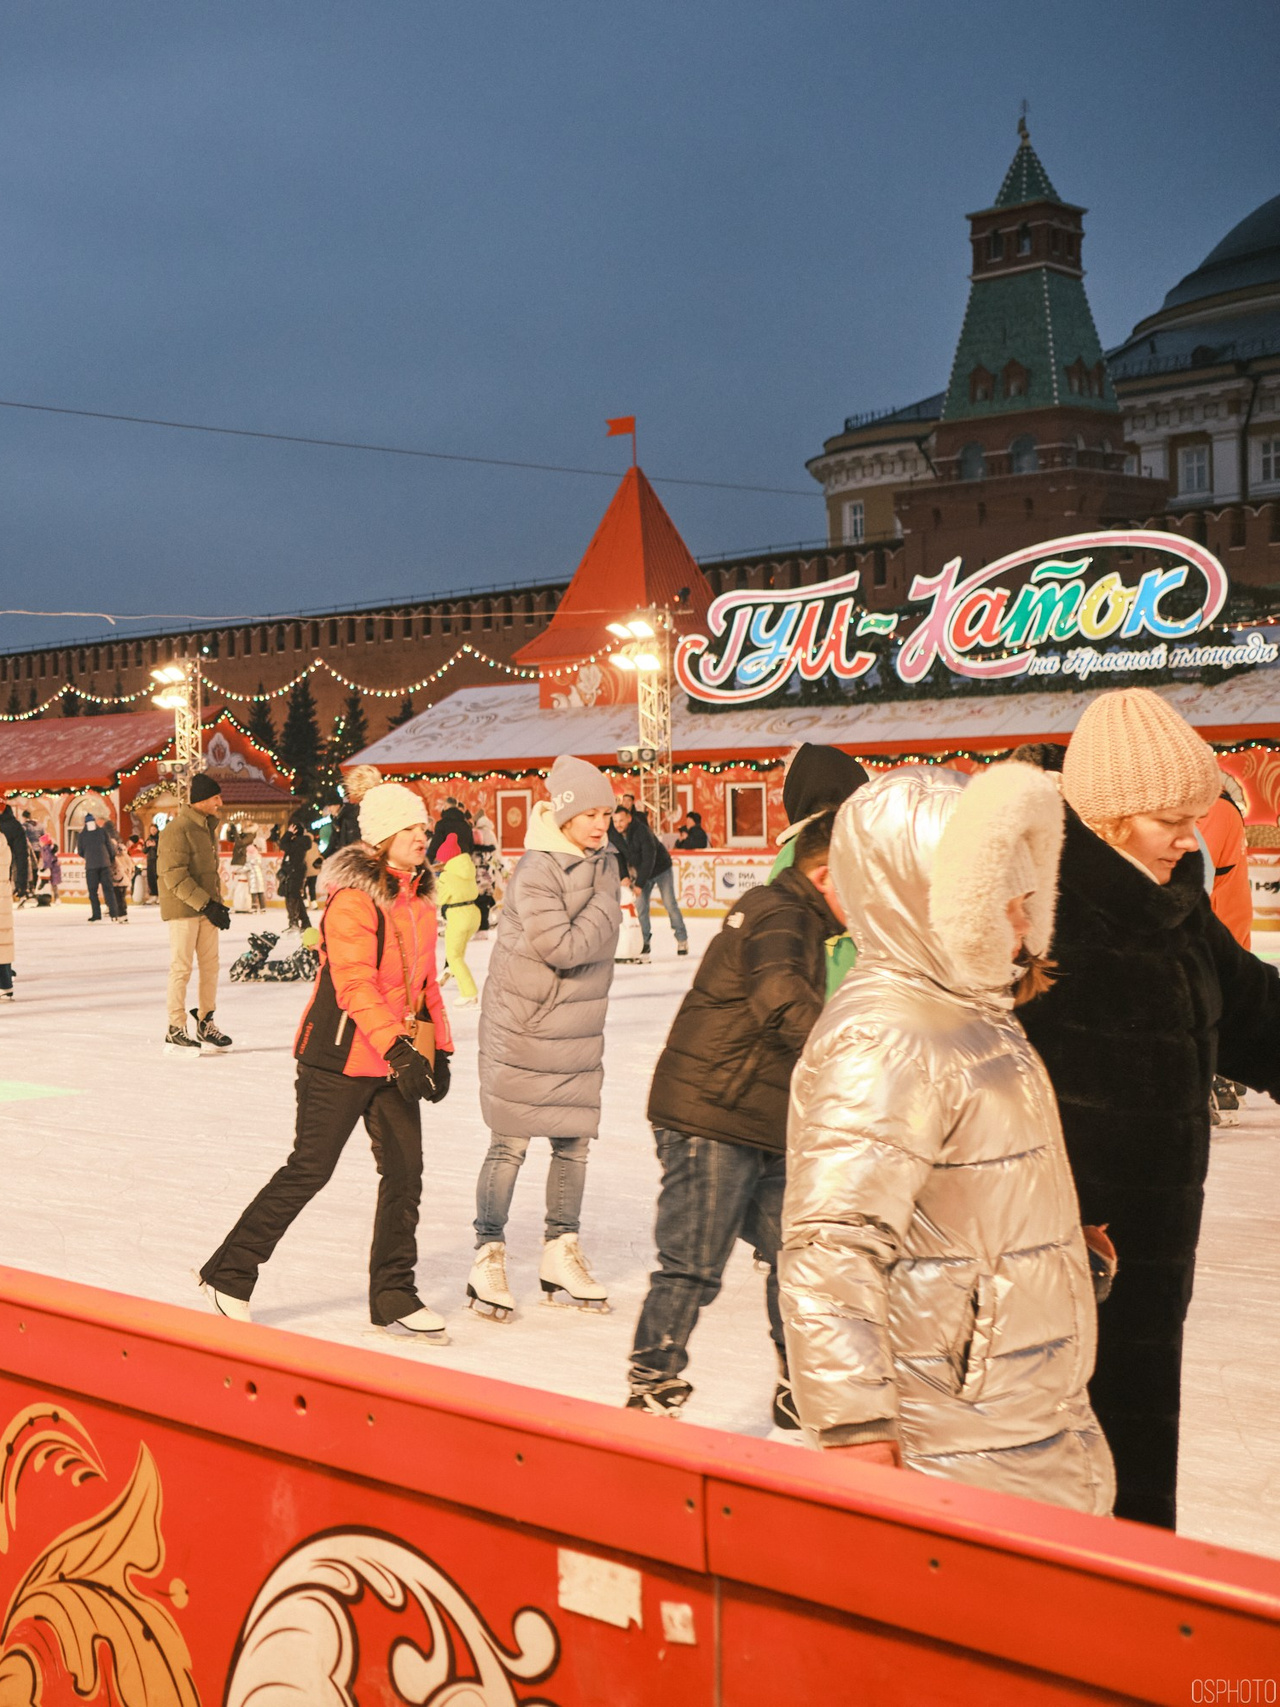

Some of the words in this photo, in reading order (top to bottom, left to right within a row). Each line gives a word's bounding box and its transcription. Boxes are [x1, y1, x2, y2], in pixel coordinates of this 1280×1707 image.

[1028, 652, 1061, 676] на
[1062, 643, 1168, 681] Красной
[1168, 632, 1279, 670] площади
[738, 872, 756, 880] РИА
